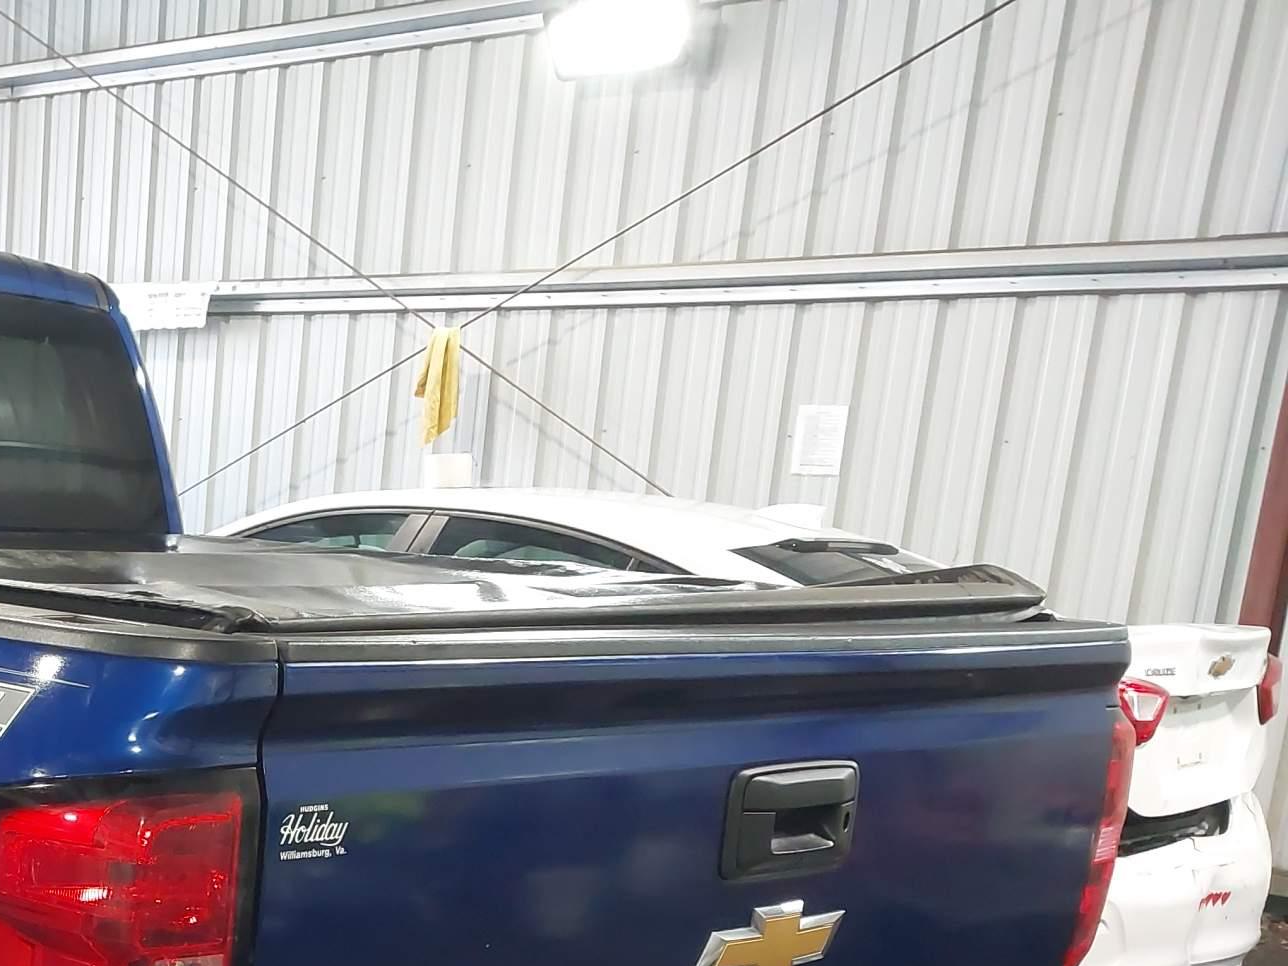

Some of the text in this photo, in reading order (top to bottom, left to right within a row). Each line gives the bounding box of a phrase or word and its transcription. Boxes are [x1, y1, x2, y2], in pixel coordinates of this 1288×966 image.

[300, 804, 329, 813] HUDGINS
[279, 811, 350, 847] Holiday
[335, 846, 348, 856] Va.
